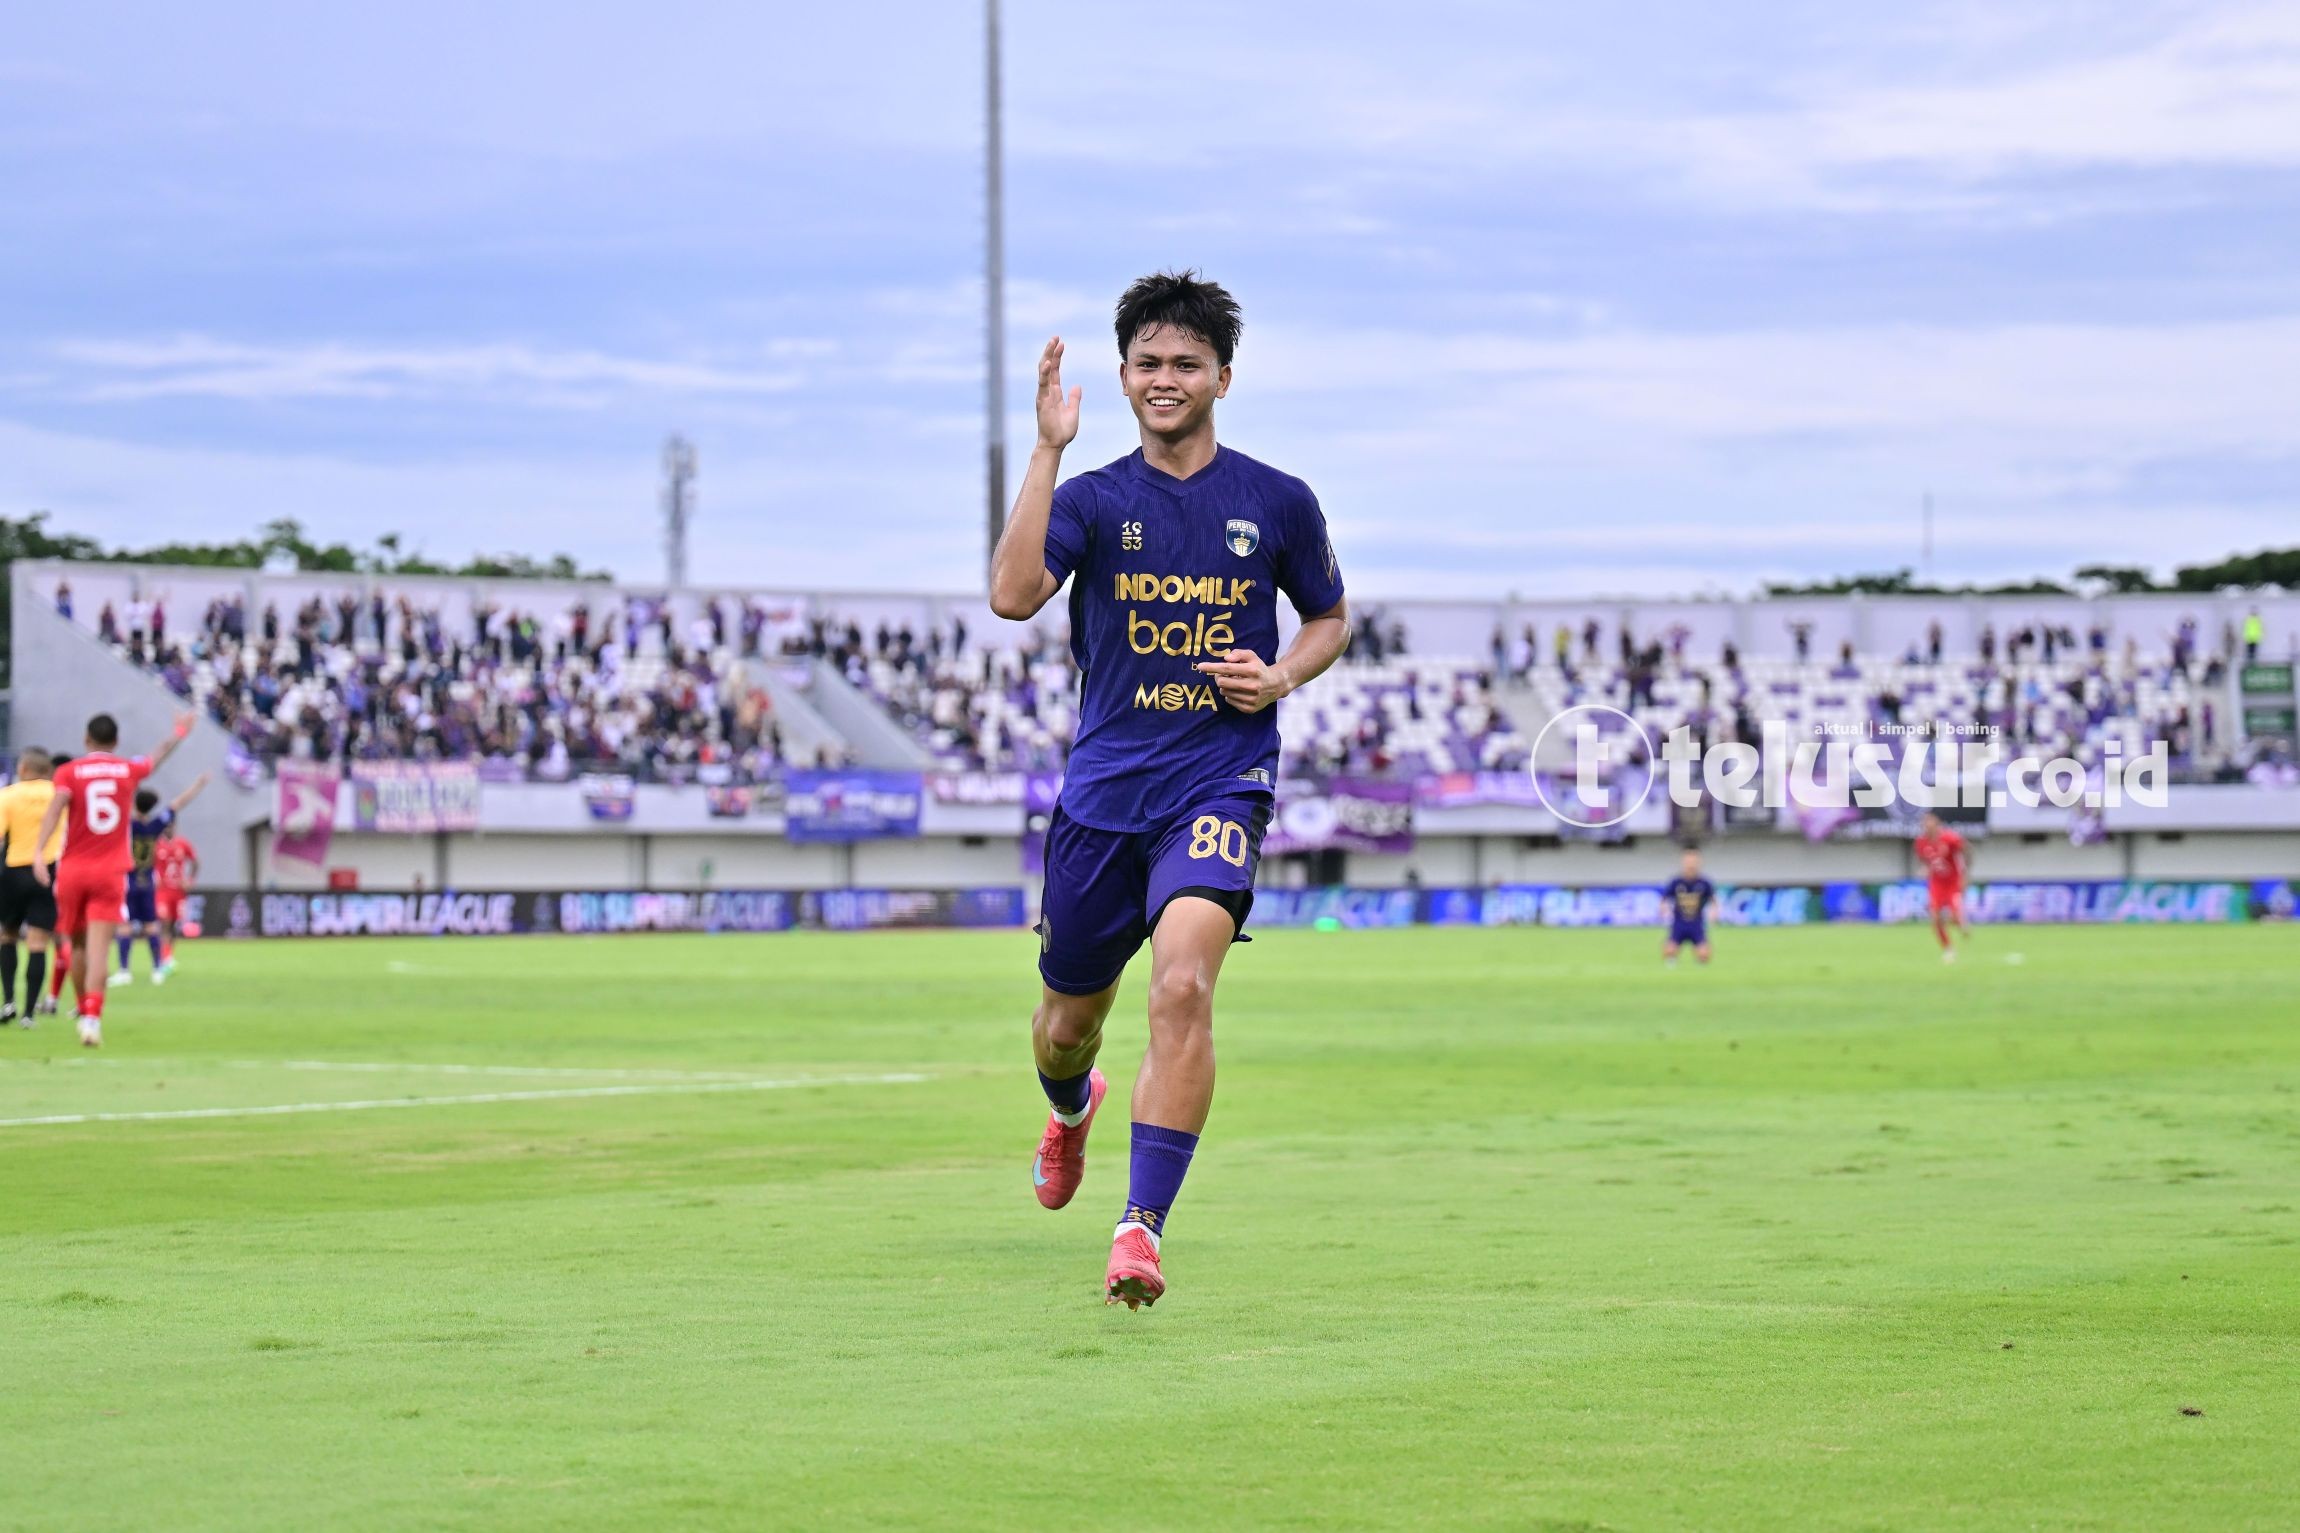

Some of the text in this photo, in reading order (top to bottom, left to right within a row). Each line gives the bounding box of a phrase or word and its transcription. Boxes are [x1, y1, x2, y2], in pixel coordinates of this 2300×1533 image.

[1122, 521, 1143, 535] 19
[1122, 537, 1143, 550] 53
[1128, 609, 1235, 657] balé
[1134, 683, 1218, 711] MOYA
[85, 779, 121, 835] 6
[1188, 815, 1248, 867] 80
[1879, 885, 1928, 922] BR
